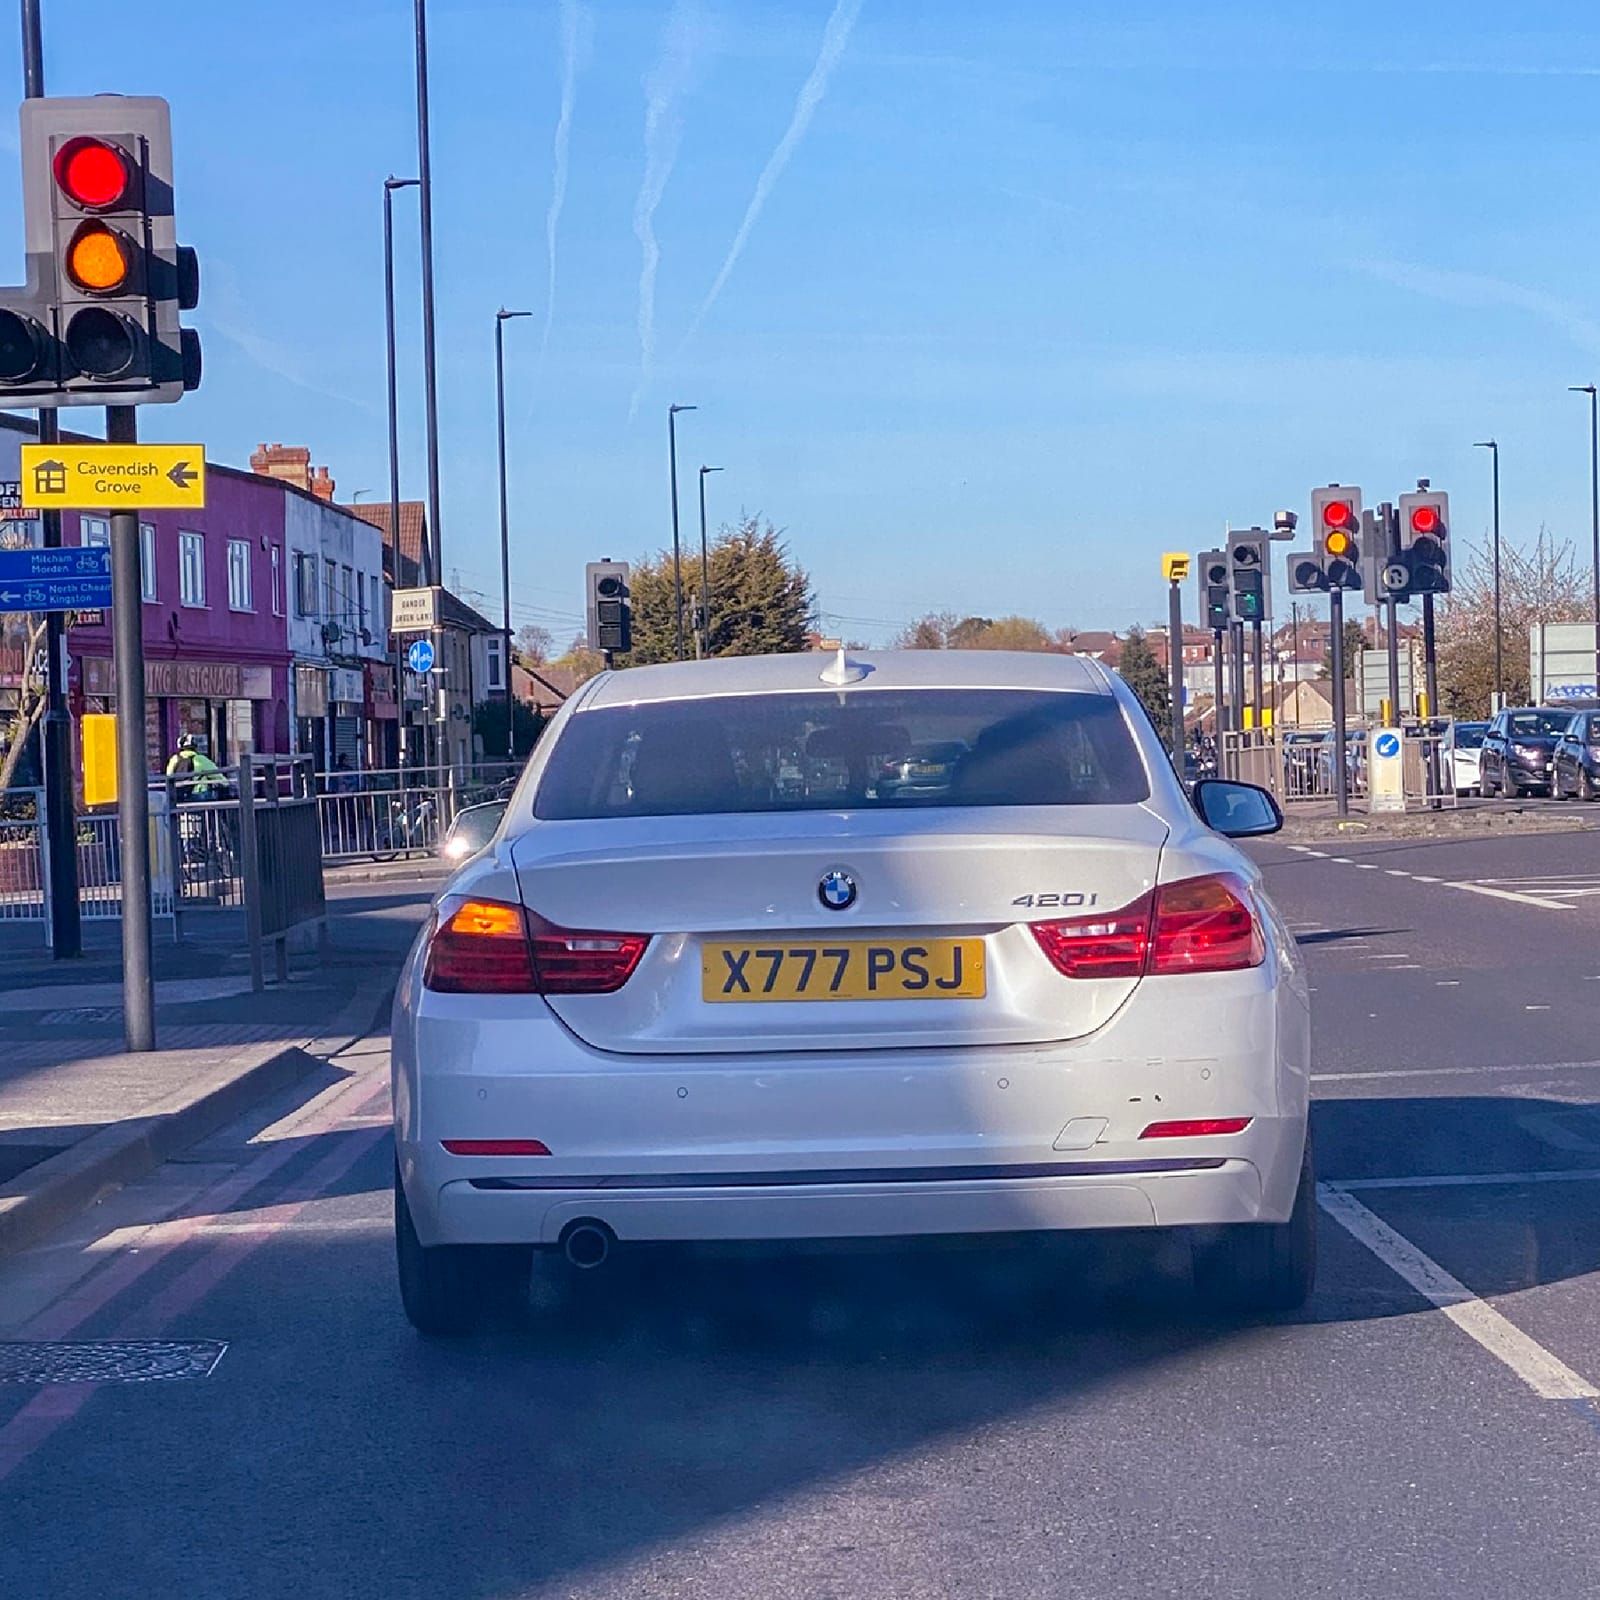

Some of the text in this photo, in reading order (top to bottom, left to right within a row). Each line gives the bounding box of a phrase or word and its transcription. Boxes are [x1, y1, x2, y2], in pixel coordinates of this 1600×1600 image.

[77, 461, 159, 477] Cavendish
[94, 479, 142, 494] Grove
[31, 554, 73, 564] Mitcham
[31, 565, 70, 574] Morden
[49, 584, 78, 594] North
[49, 594, 92, 604] Kingston
[722, 946, 962, 993] X777 PSJ
